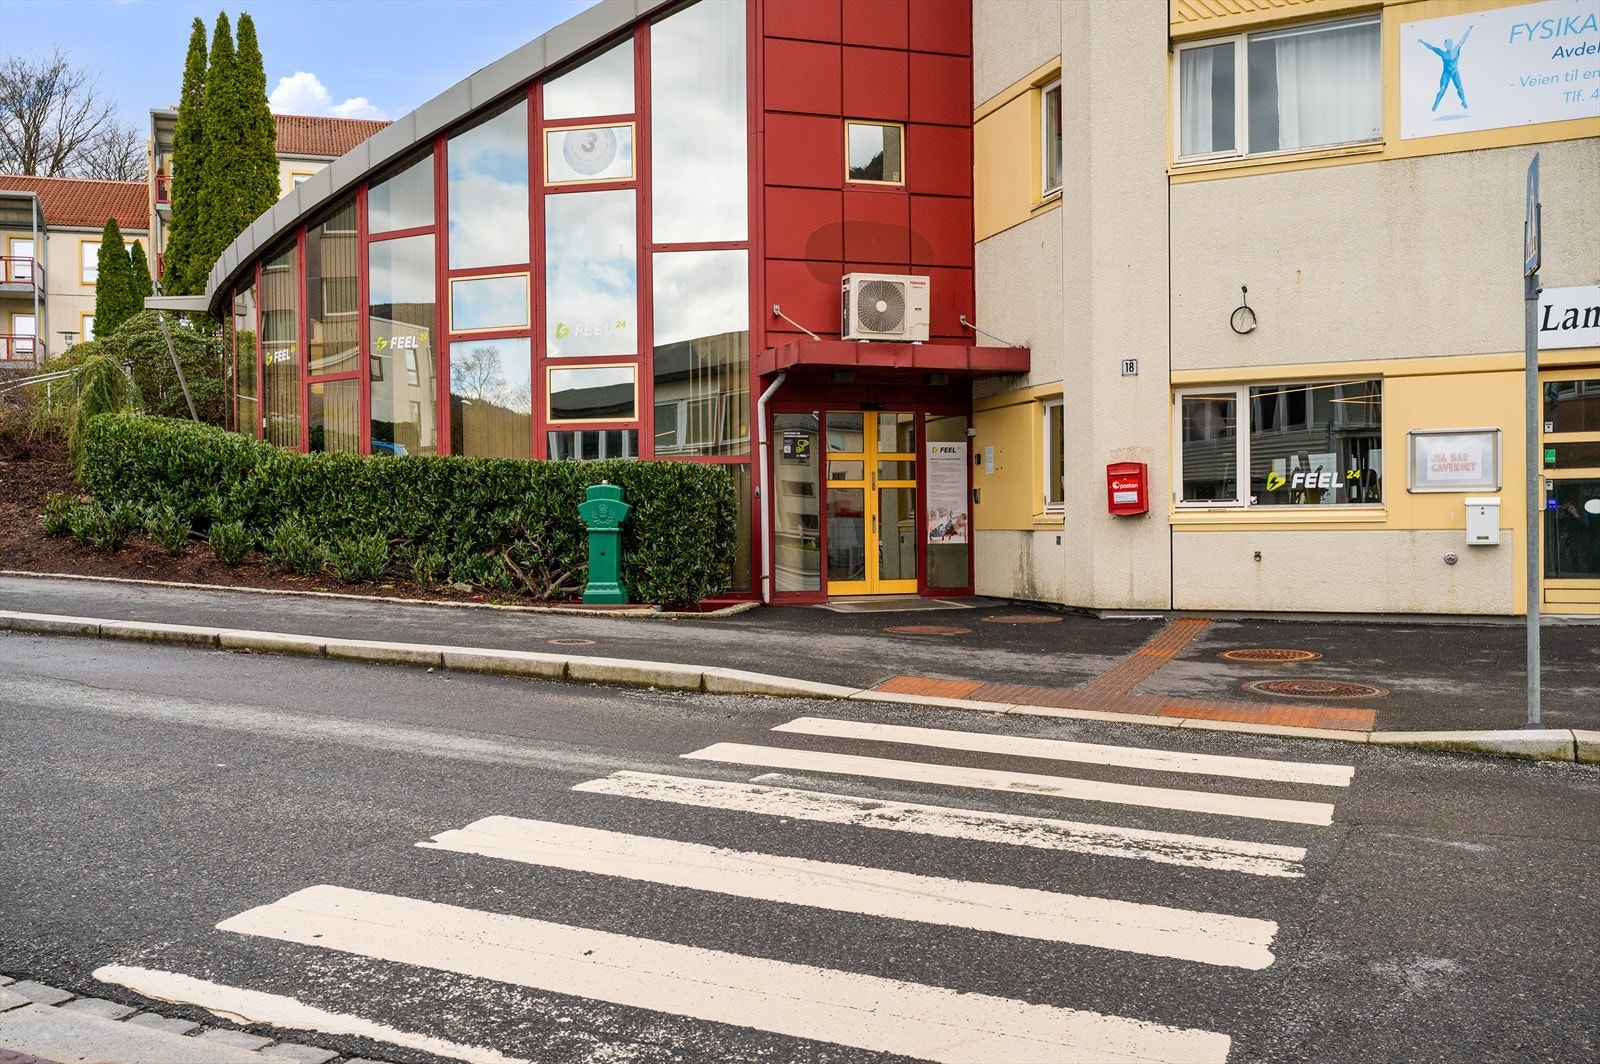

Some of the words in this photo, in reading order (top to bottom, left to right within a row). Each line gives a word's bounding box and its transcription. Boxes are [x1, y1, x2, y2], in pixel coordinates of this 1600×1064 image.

[1509, 13, 1598, 44] FYSIKA
[1519, 75, 1559, 87] Veien
[1563, 69, 1579, 82] til
[1563, 89, 1585, 103] Tlf.
[581, 132, 598, 153] 3
[575, 322, 615, 337] FEEL
[390, 336, 419, 349] FEEL
[274, 348, 290, 363] FEEL
[1125, 361, 1135, 373] 18
[1291, 472, 1344, 489] FEEL
[1346, 469, 1361, 479] 24
